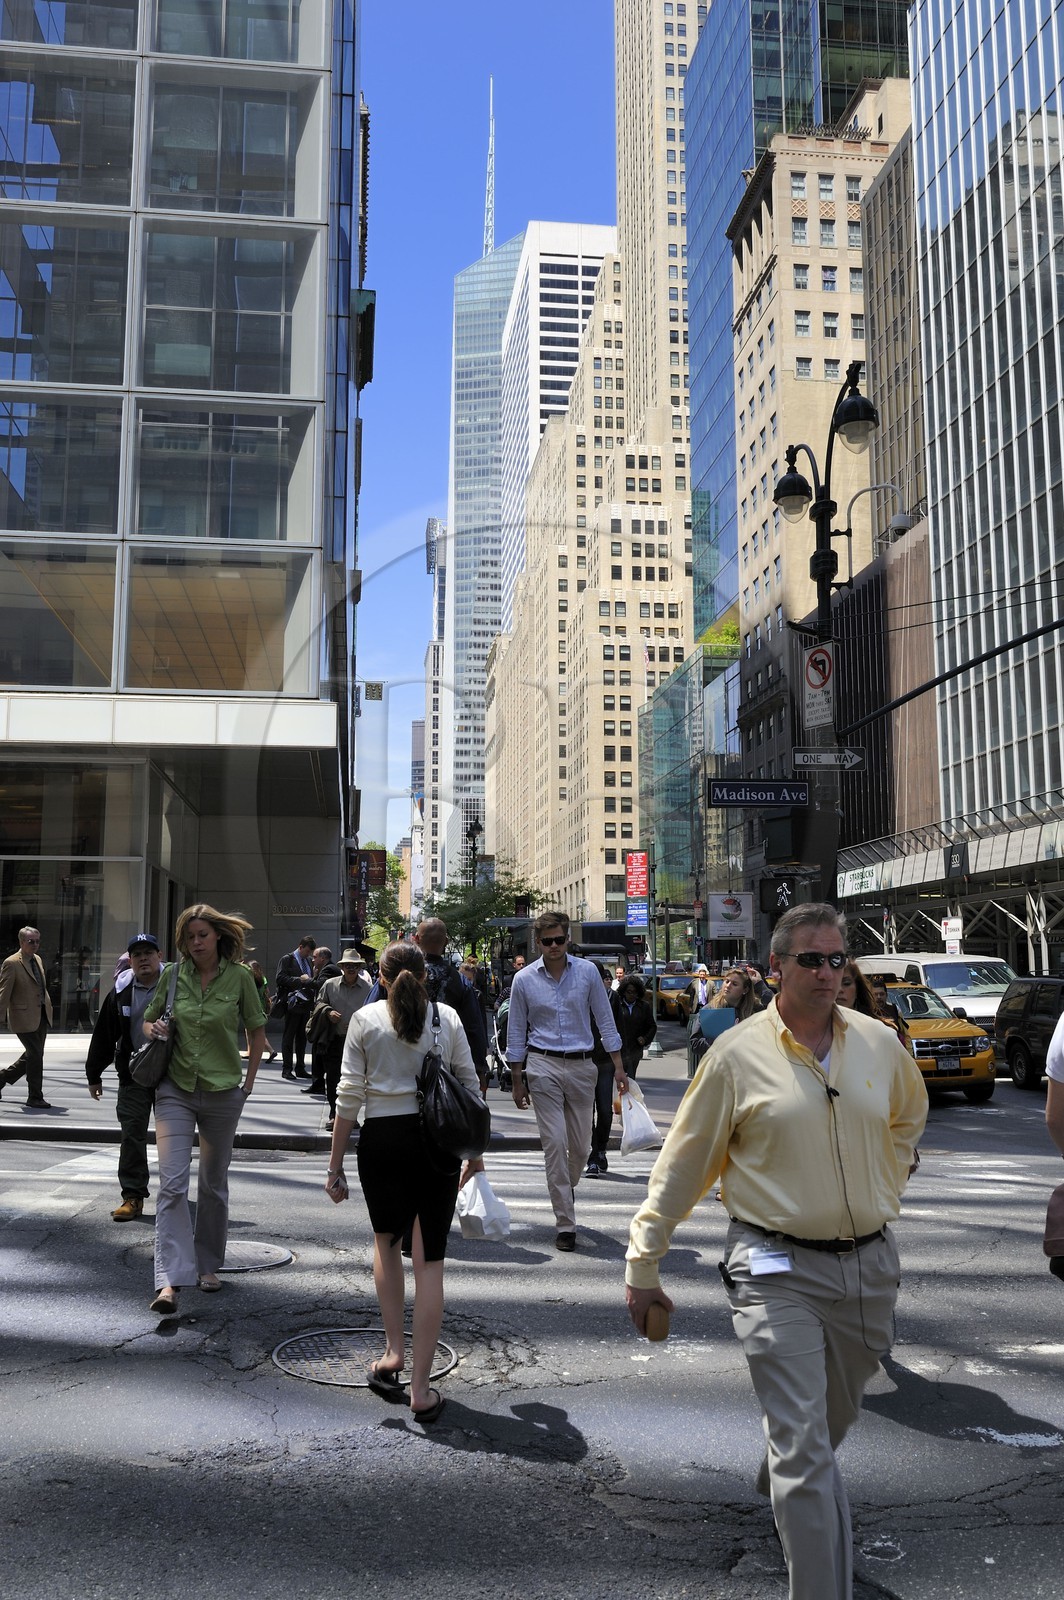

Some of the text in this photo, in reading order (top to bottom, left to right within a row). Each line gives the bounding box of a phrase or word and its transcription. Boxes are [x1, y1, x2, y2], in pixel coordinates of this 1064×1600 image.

[802, 754, 855, 764] ONE WAY
[713, 787, 807, 801] Madison Ave
[951, 853, 960, 865] 330
[849, 869, 874, 882] STARBUCKS
[854, 880, 869, 891] COFFEE
[272, 905, 336, 914] 300 MADISON
